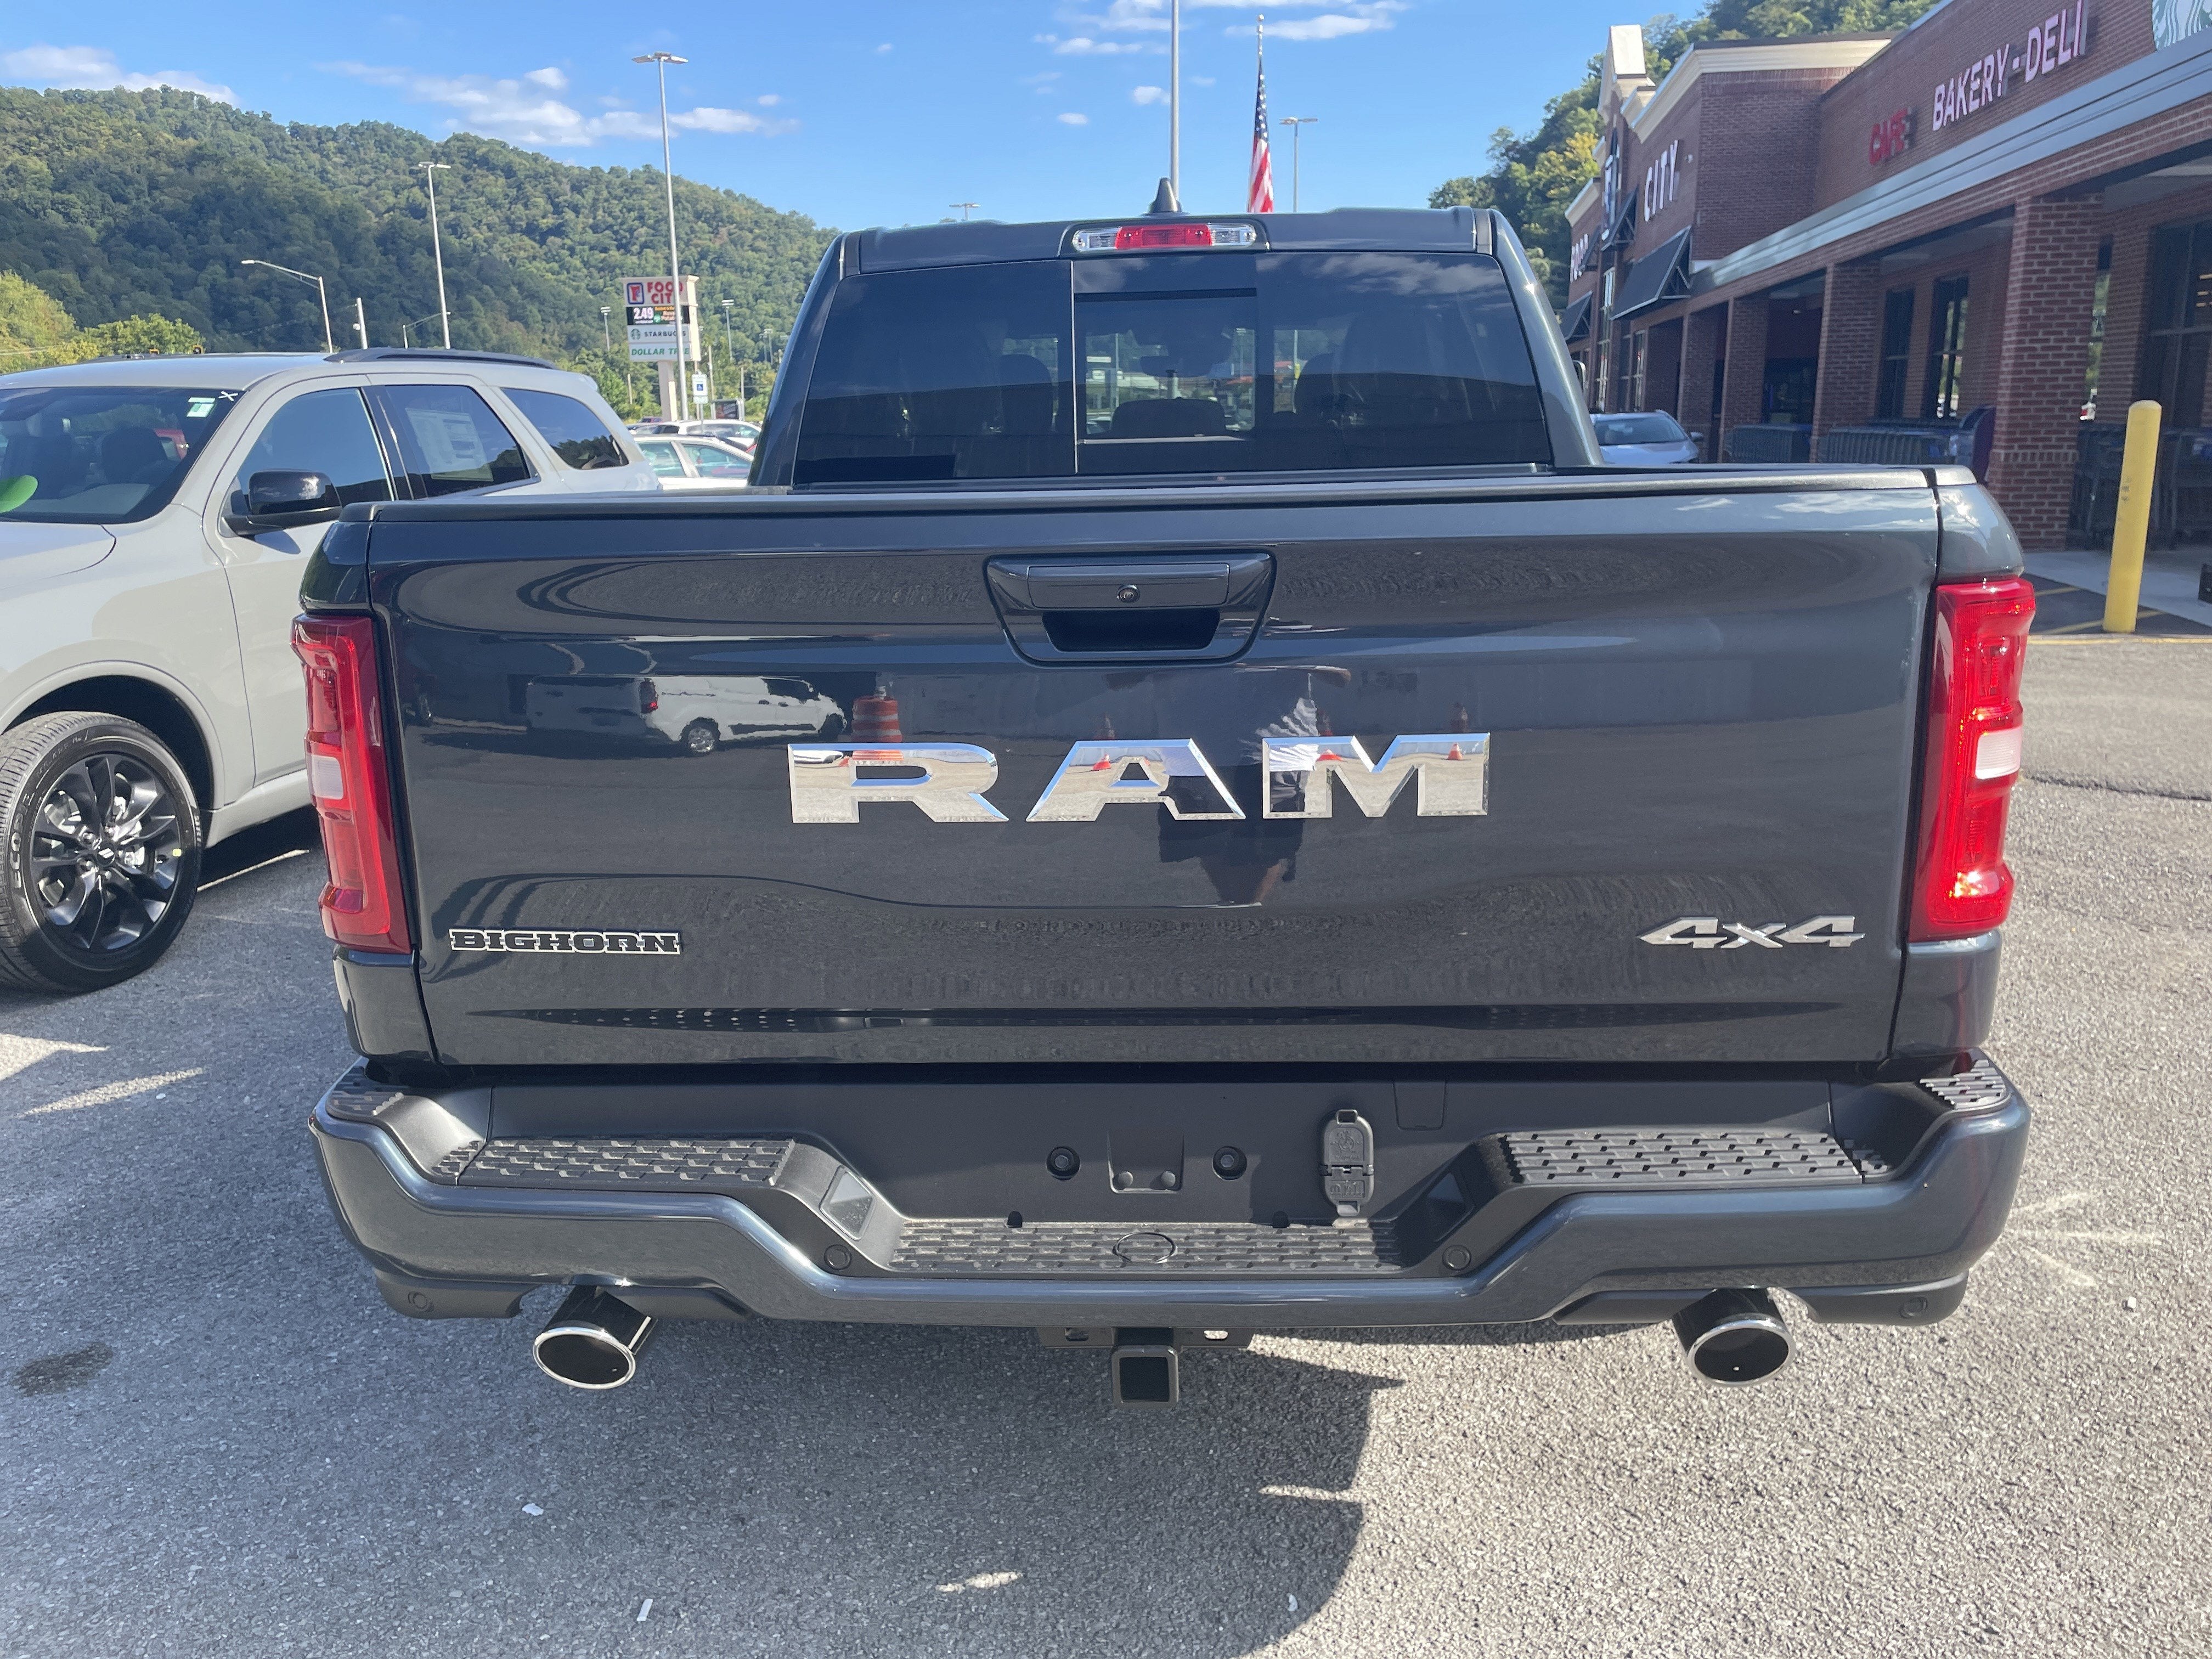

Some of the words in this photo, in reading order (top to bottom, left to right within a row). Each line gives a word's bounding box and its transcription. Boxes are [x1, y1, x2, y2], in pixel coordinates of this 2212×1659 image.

[1644, 139, 1678, 222] CITY
[651, 293, 673, 304] CIT
[787, 732, 1491, 823] RAM
[449, 928, 681, 955] BIGHORN
